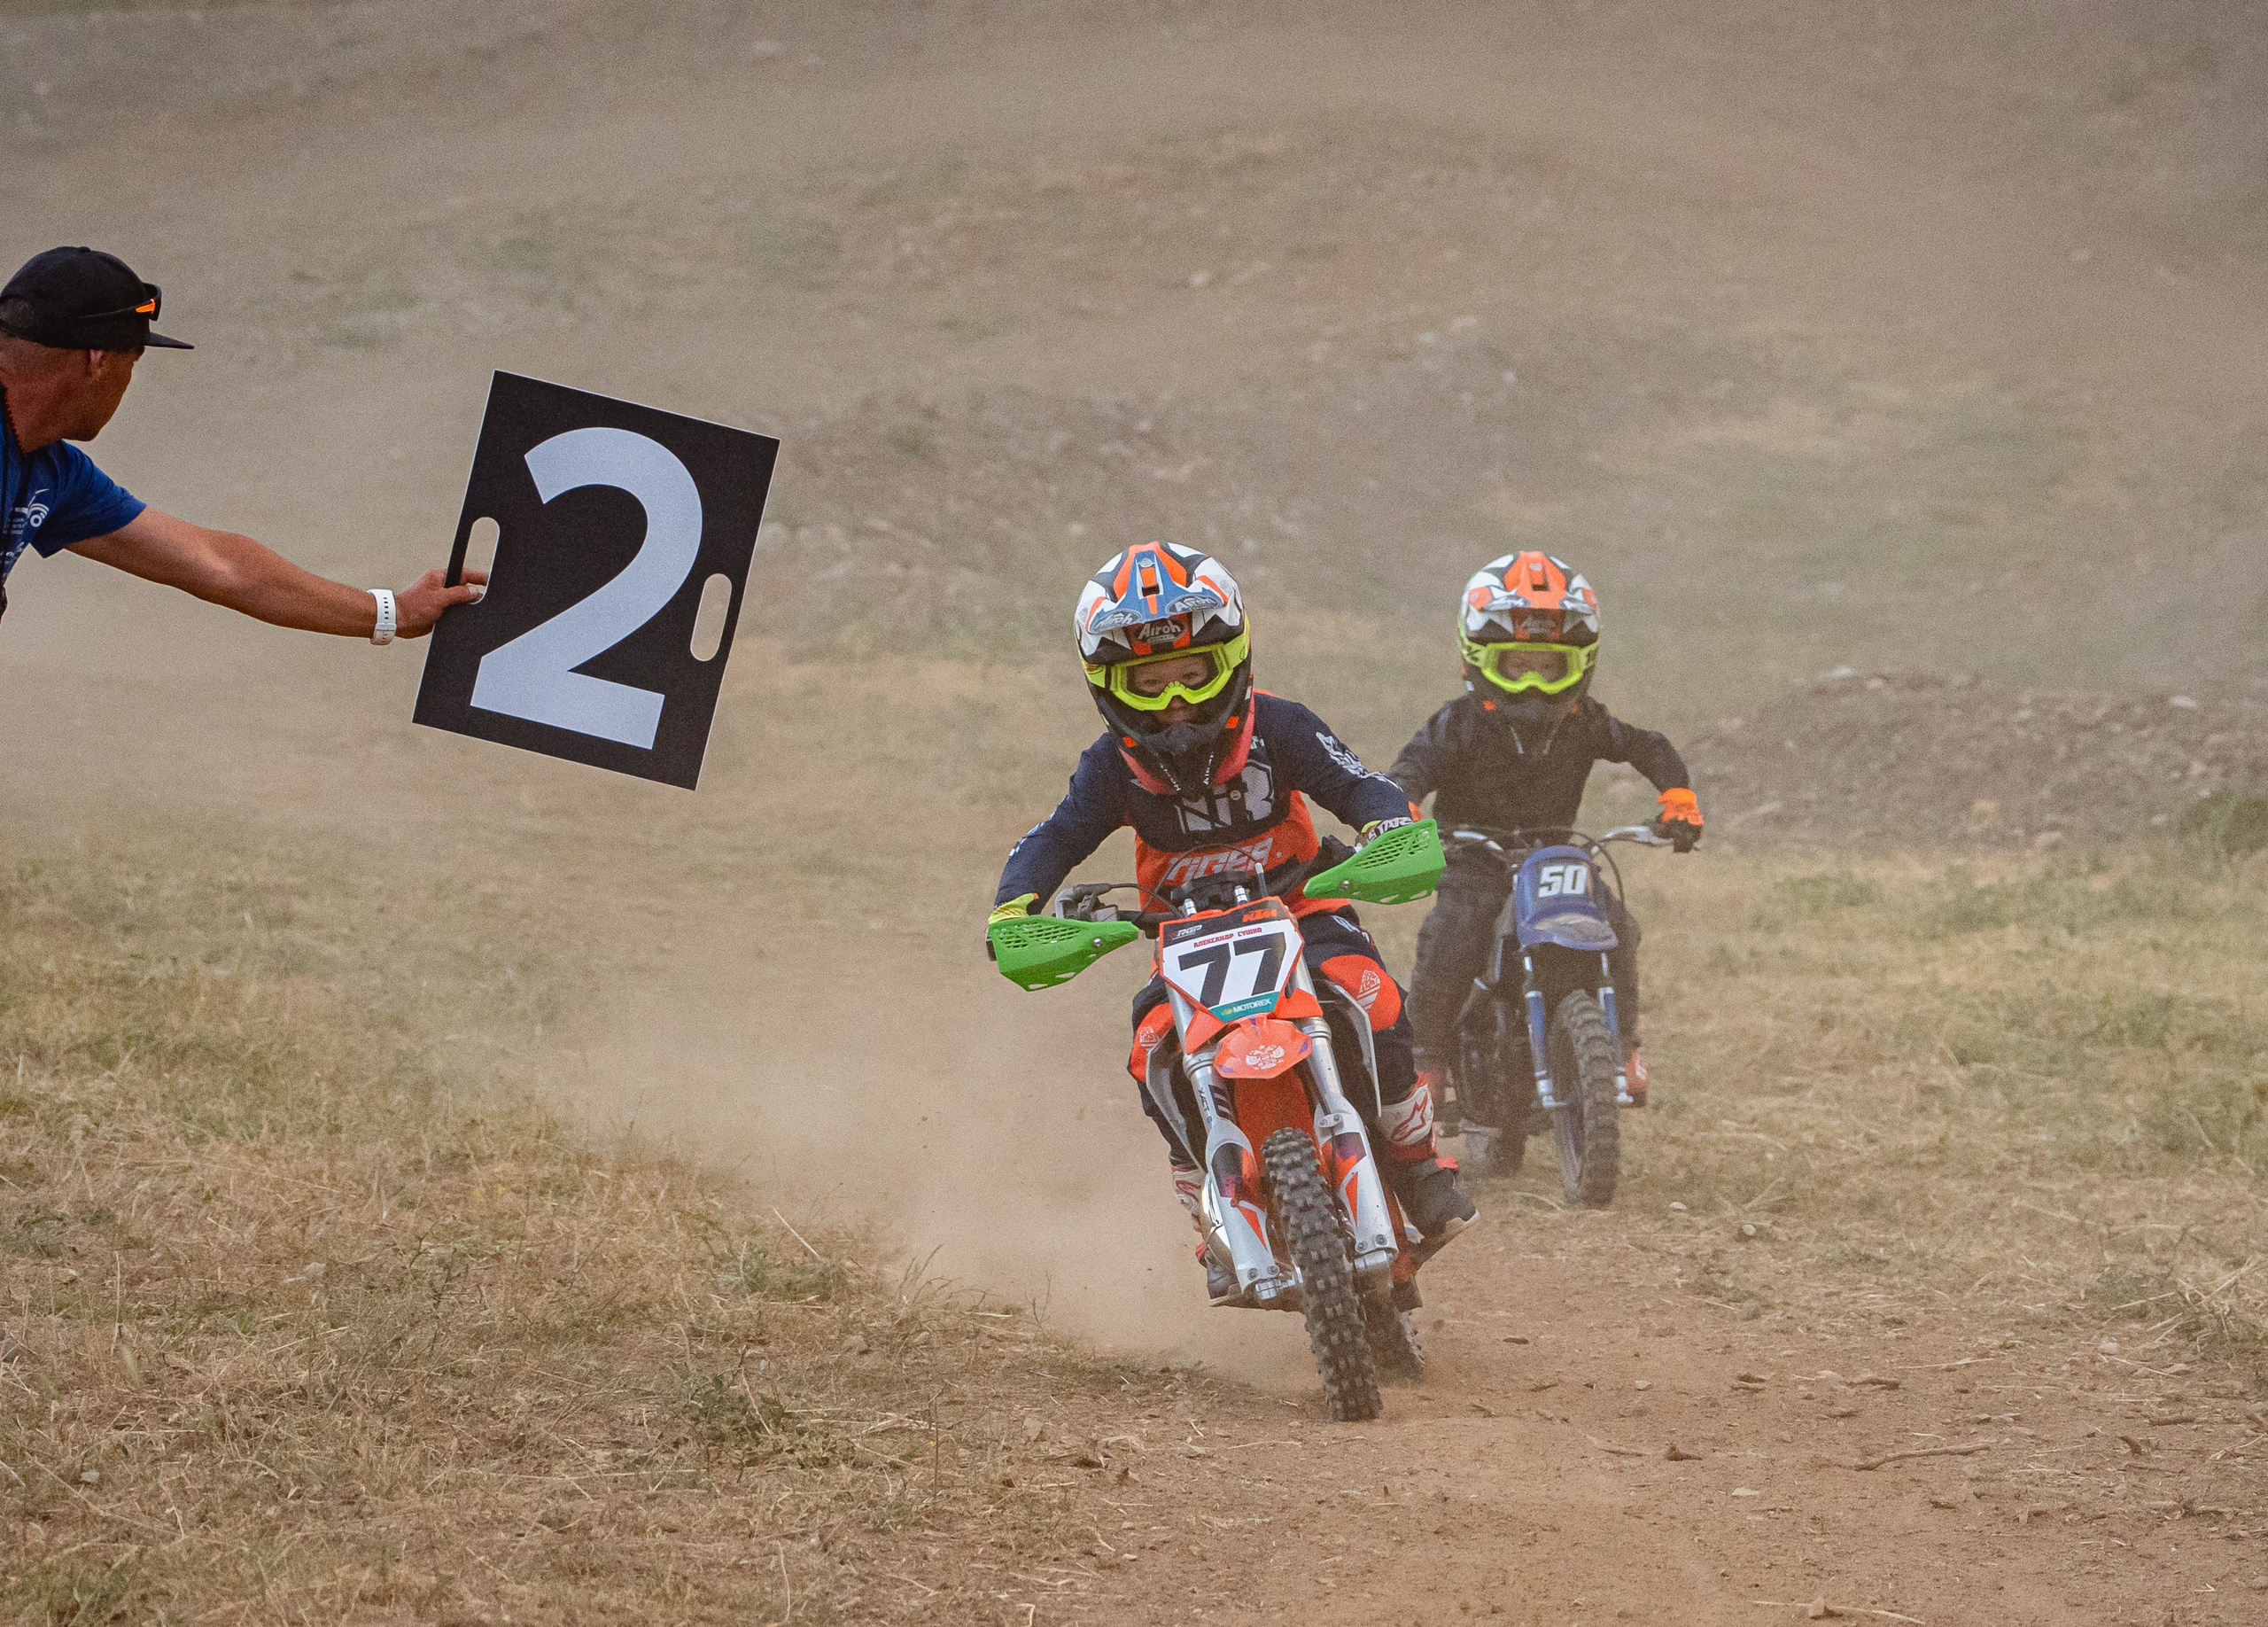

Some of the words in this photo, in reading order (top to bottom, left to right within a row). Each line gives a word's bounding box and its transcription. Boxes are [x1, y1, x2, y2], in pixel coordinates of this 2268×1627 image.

[470, 426, 703, 751] 2
[1138, 619, 1182, 640] Airoh
[1537, 864, 1588, 899] 50
[1242, 908, 1278, 923] KTM
[1177, 931, 1287, 1007] 77
[1232, 998, 1272, 1013] MOTOREX
